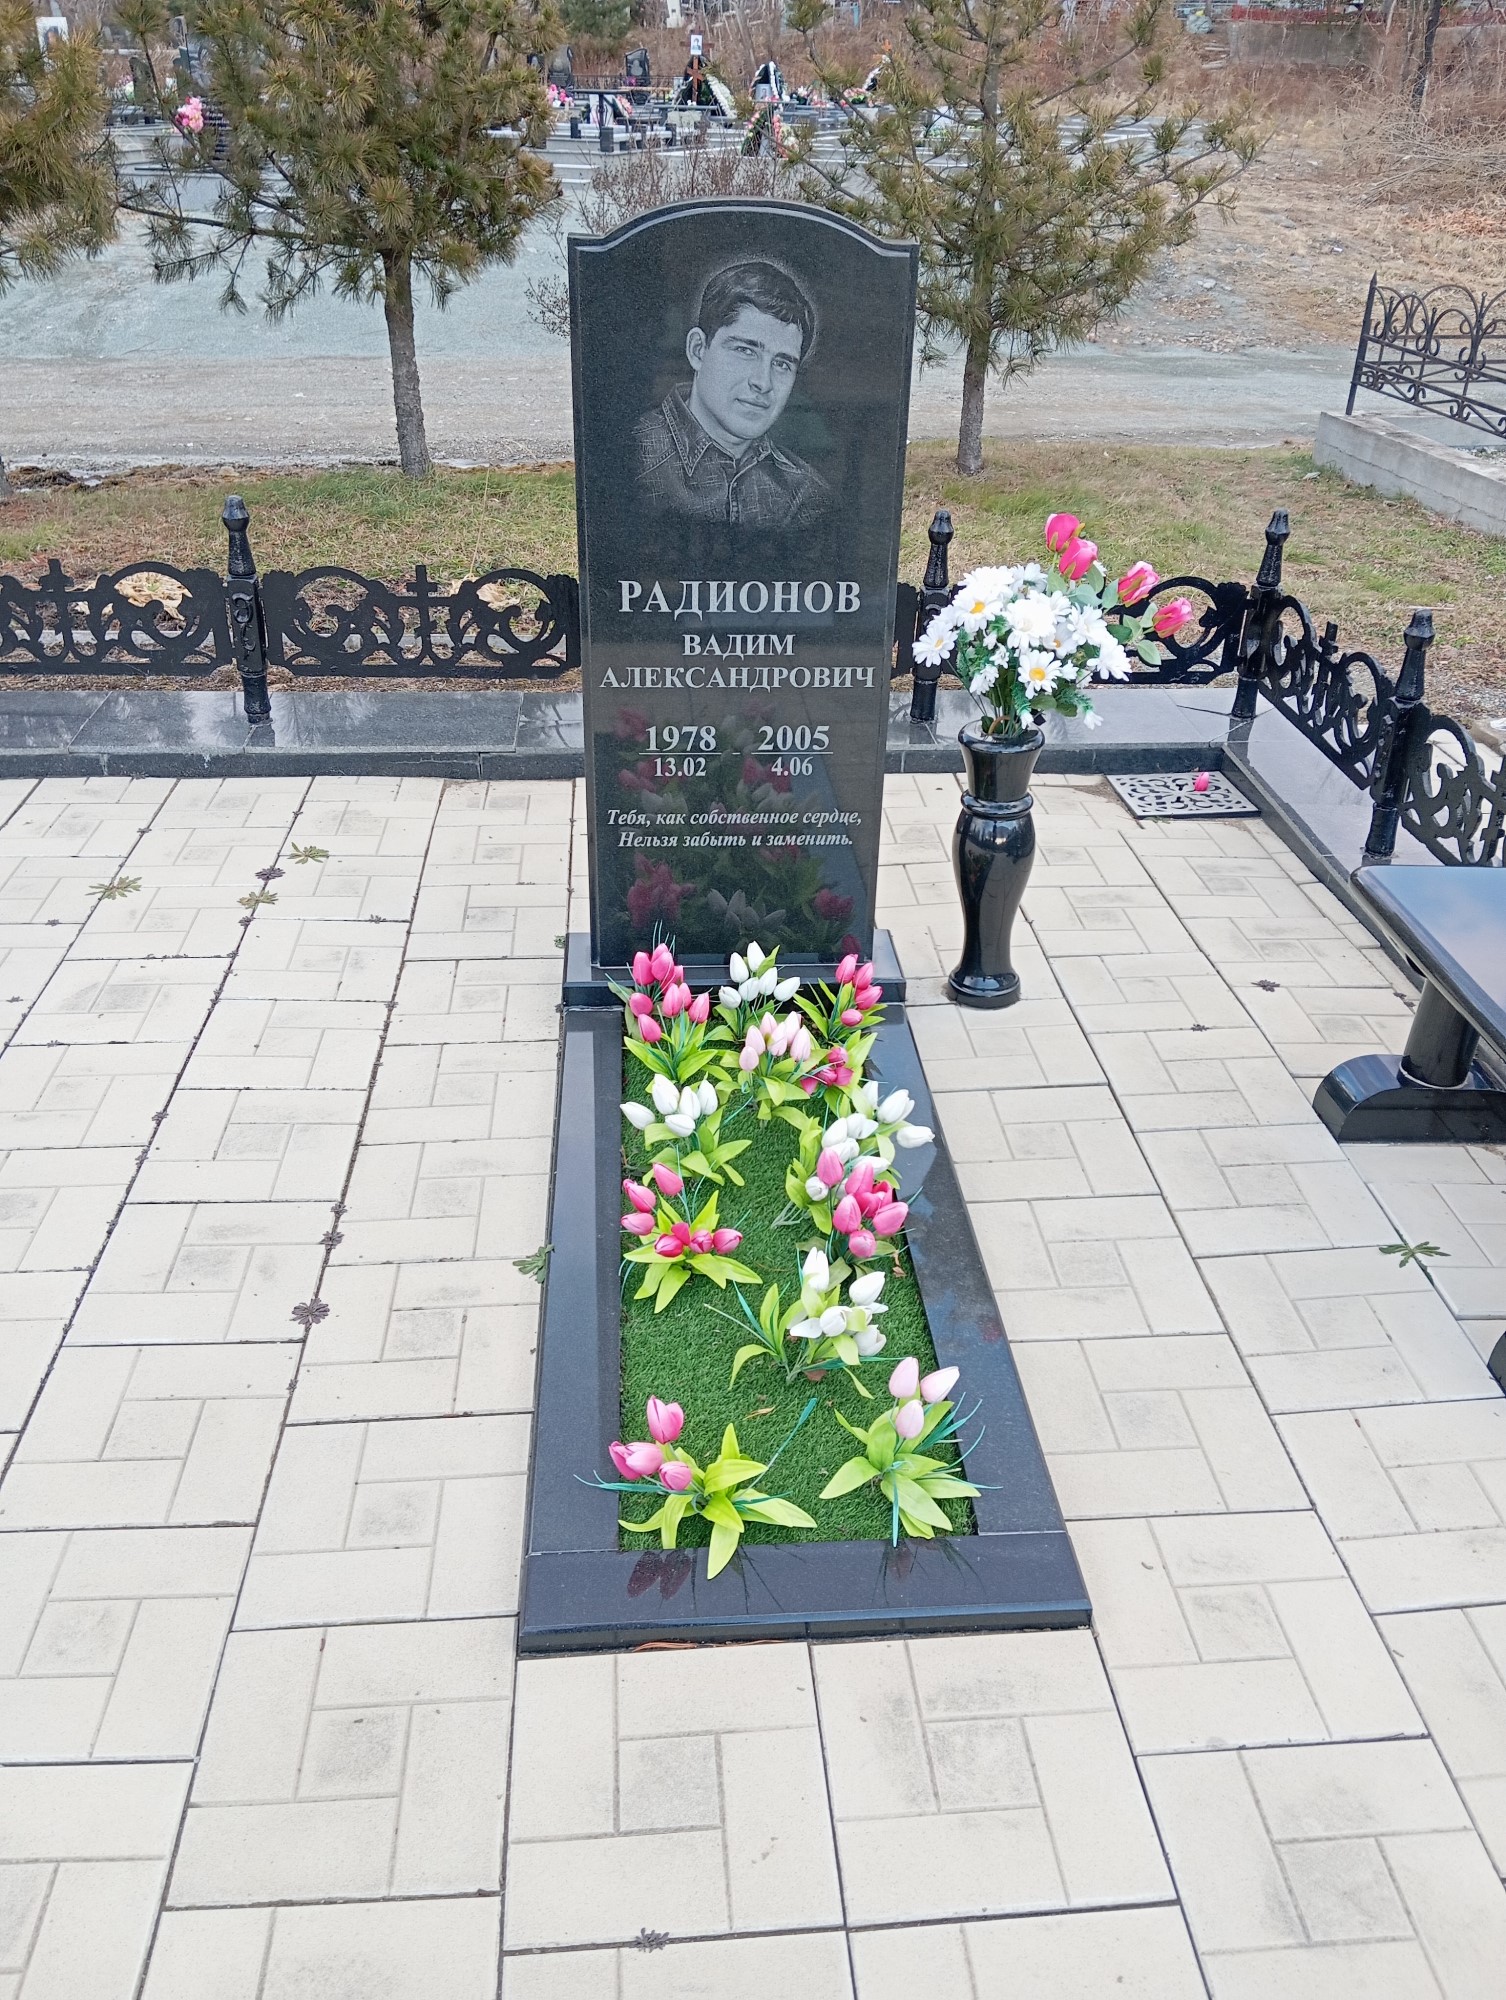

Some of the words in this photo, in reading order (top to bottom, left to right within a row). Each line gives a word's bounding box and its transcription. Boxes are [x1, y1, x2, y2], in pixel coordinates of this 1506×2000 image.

[618, 580, 861, 620] РАДИОНОВ
[682, 634, 795, 660] ВАДИМ
[599, 666, 876, 693] АЛЕКСАНДРОВИЧ
[645, 725, 717, 751] 1978
[758, 725, 830, 751] 2005
[653, 757, 707, 777] 13.02
[771, 757, 813, 776] 4.06
[607, 809, 651, 827] Тебя,
[656, 814, 686, 825] как
[690, 809, 798, 824] собственное
[802, 809, 863, 829] сердце,
[617, 831, 678, 847] Нельзя
[683, 832, 747, 847] забыть
[751, 835, 762, 846] и
[767, 833, 854, 846] заменить.
